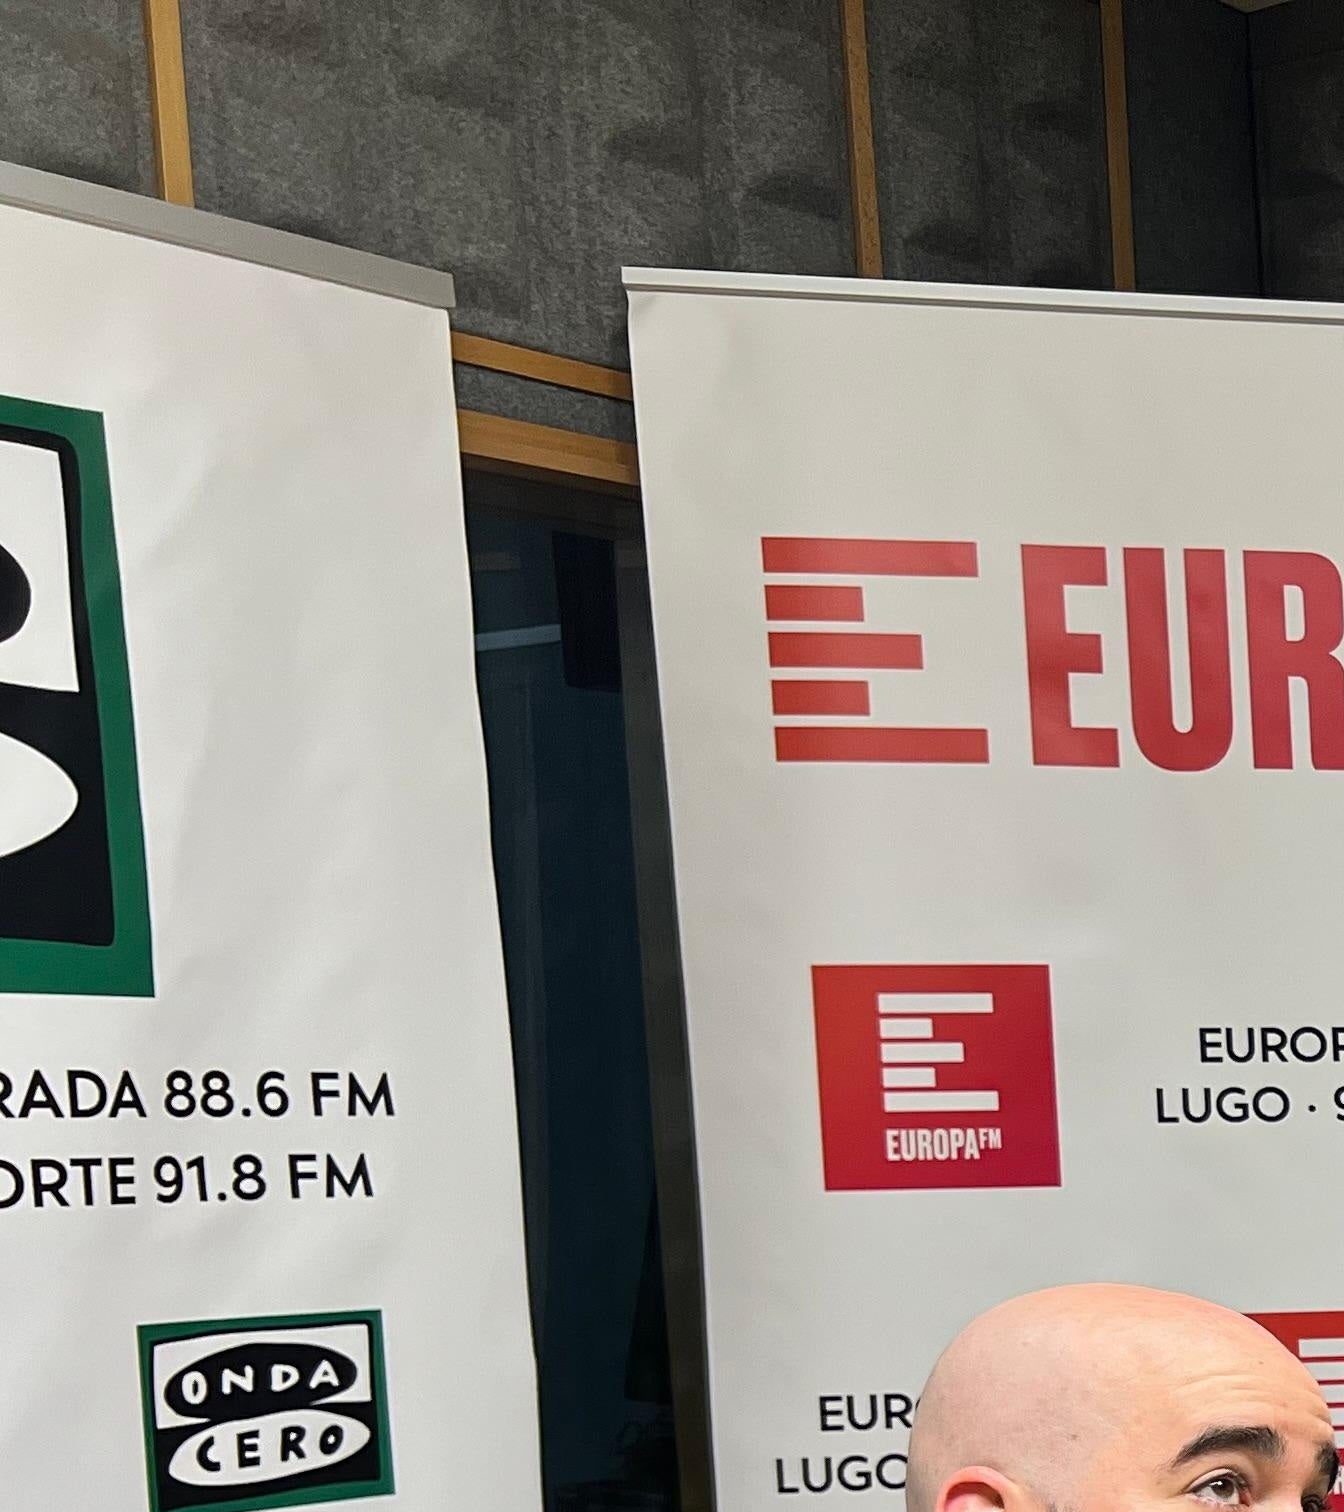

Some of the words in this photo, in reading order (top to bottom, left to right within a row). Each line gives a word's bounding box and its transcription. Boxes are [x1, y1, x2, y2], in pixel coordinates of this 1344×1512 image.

[165, 1070, 290, 1119] 88.6
[311, 1072, 396, 1118] FM
[1157, 1087, 1291, 1125] LUGO
[154, 1154, 268, 1205] 91.8
[289, 1154, 374, 1200] FM
[180, 1358, 340, 1406] ONDA
[818, 1394, 921, 1432] EUR
[196, 1424, 345, 1473] CERO
